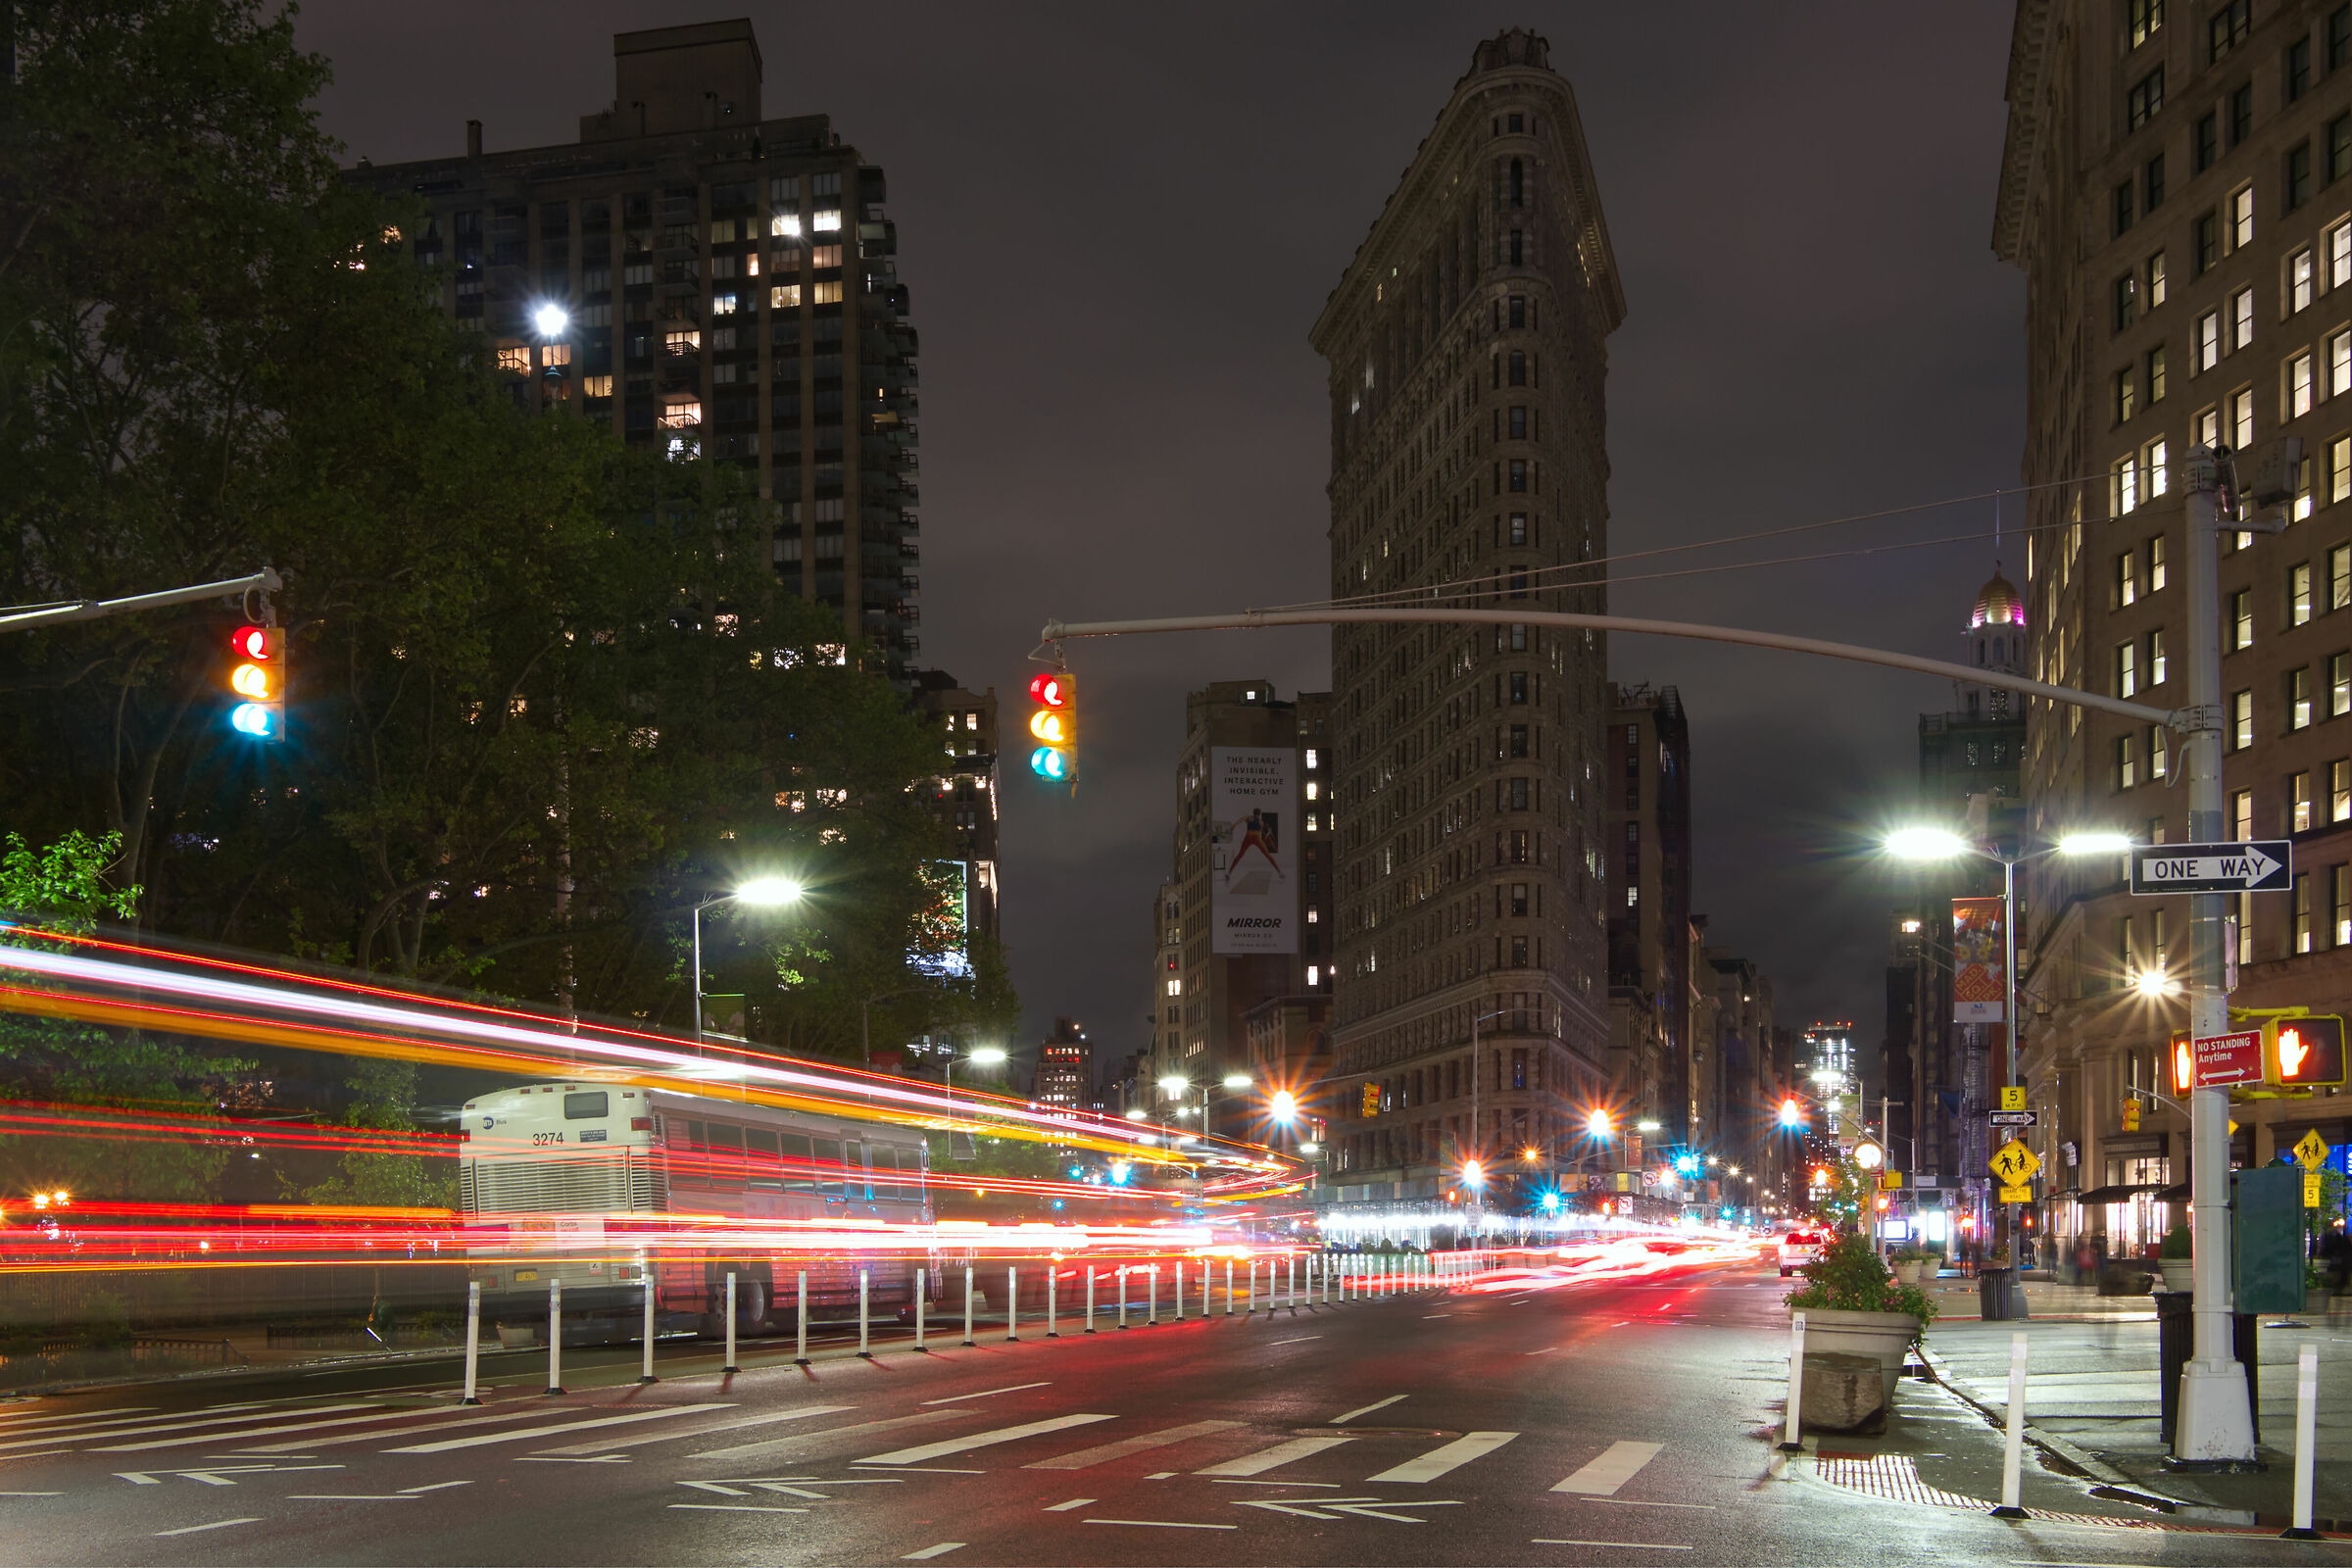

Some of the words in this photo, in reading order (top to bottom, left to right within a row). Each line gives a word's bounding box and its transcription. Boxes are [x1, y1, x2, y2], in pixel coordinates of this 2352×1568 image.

[2155, 859, 2199, 878] ONE
[2220, 858, 2266, 876] WAY
[1227, 917, 1282, 928] MIRROR
[2197, 1042, 2210, 1053] NO
[2210, 1037, 2251, 1052] STANDING
[2198, 1052, 2232, 1064] Anytime
[2009, 1090, 2018, 1102] 5
[532, 1132, 564, 1147] 3274
[2308, 1189, 2315, 1200] 5
